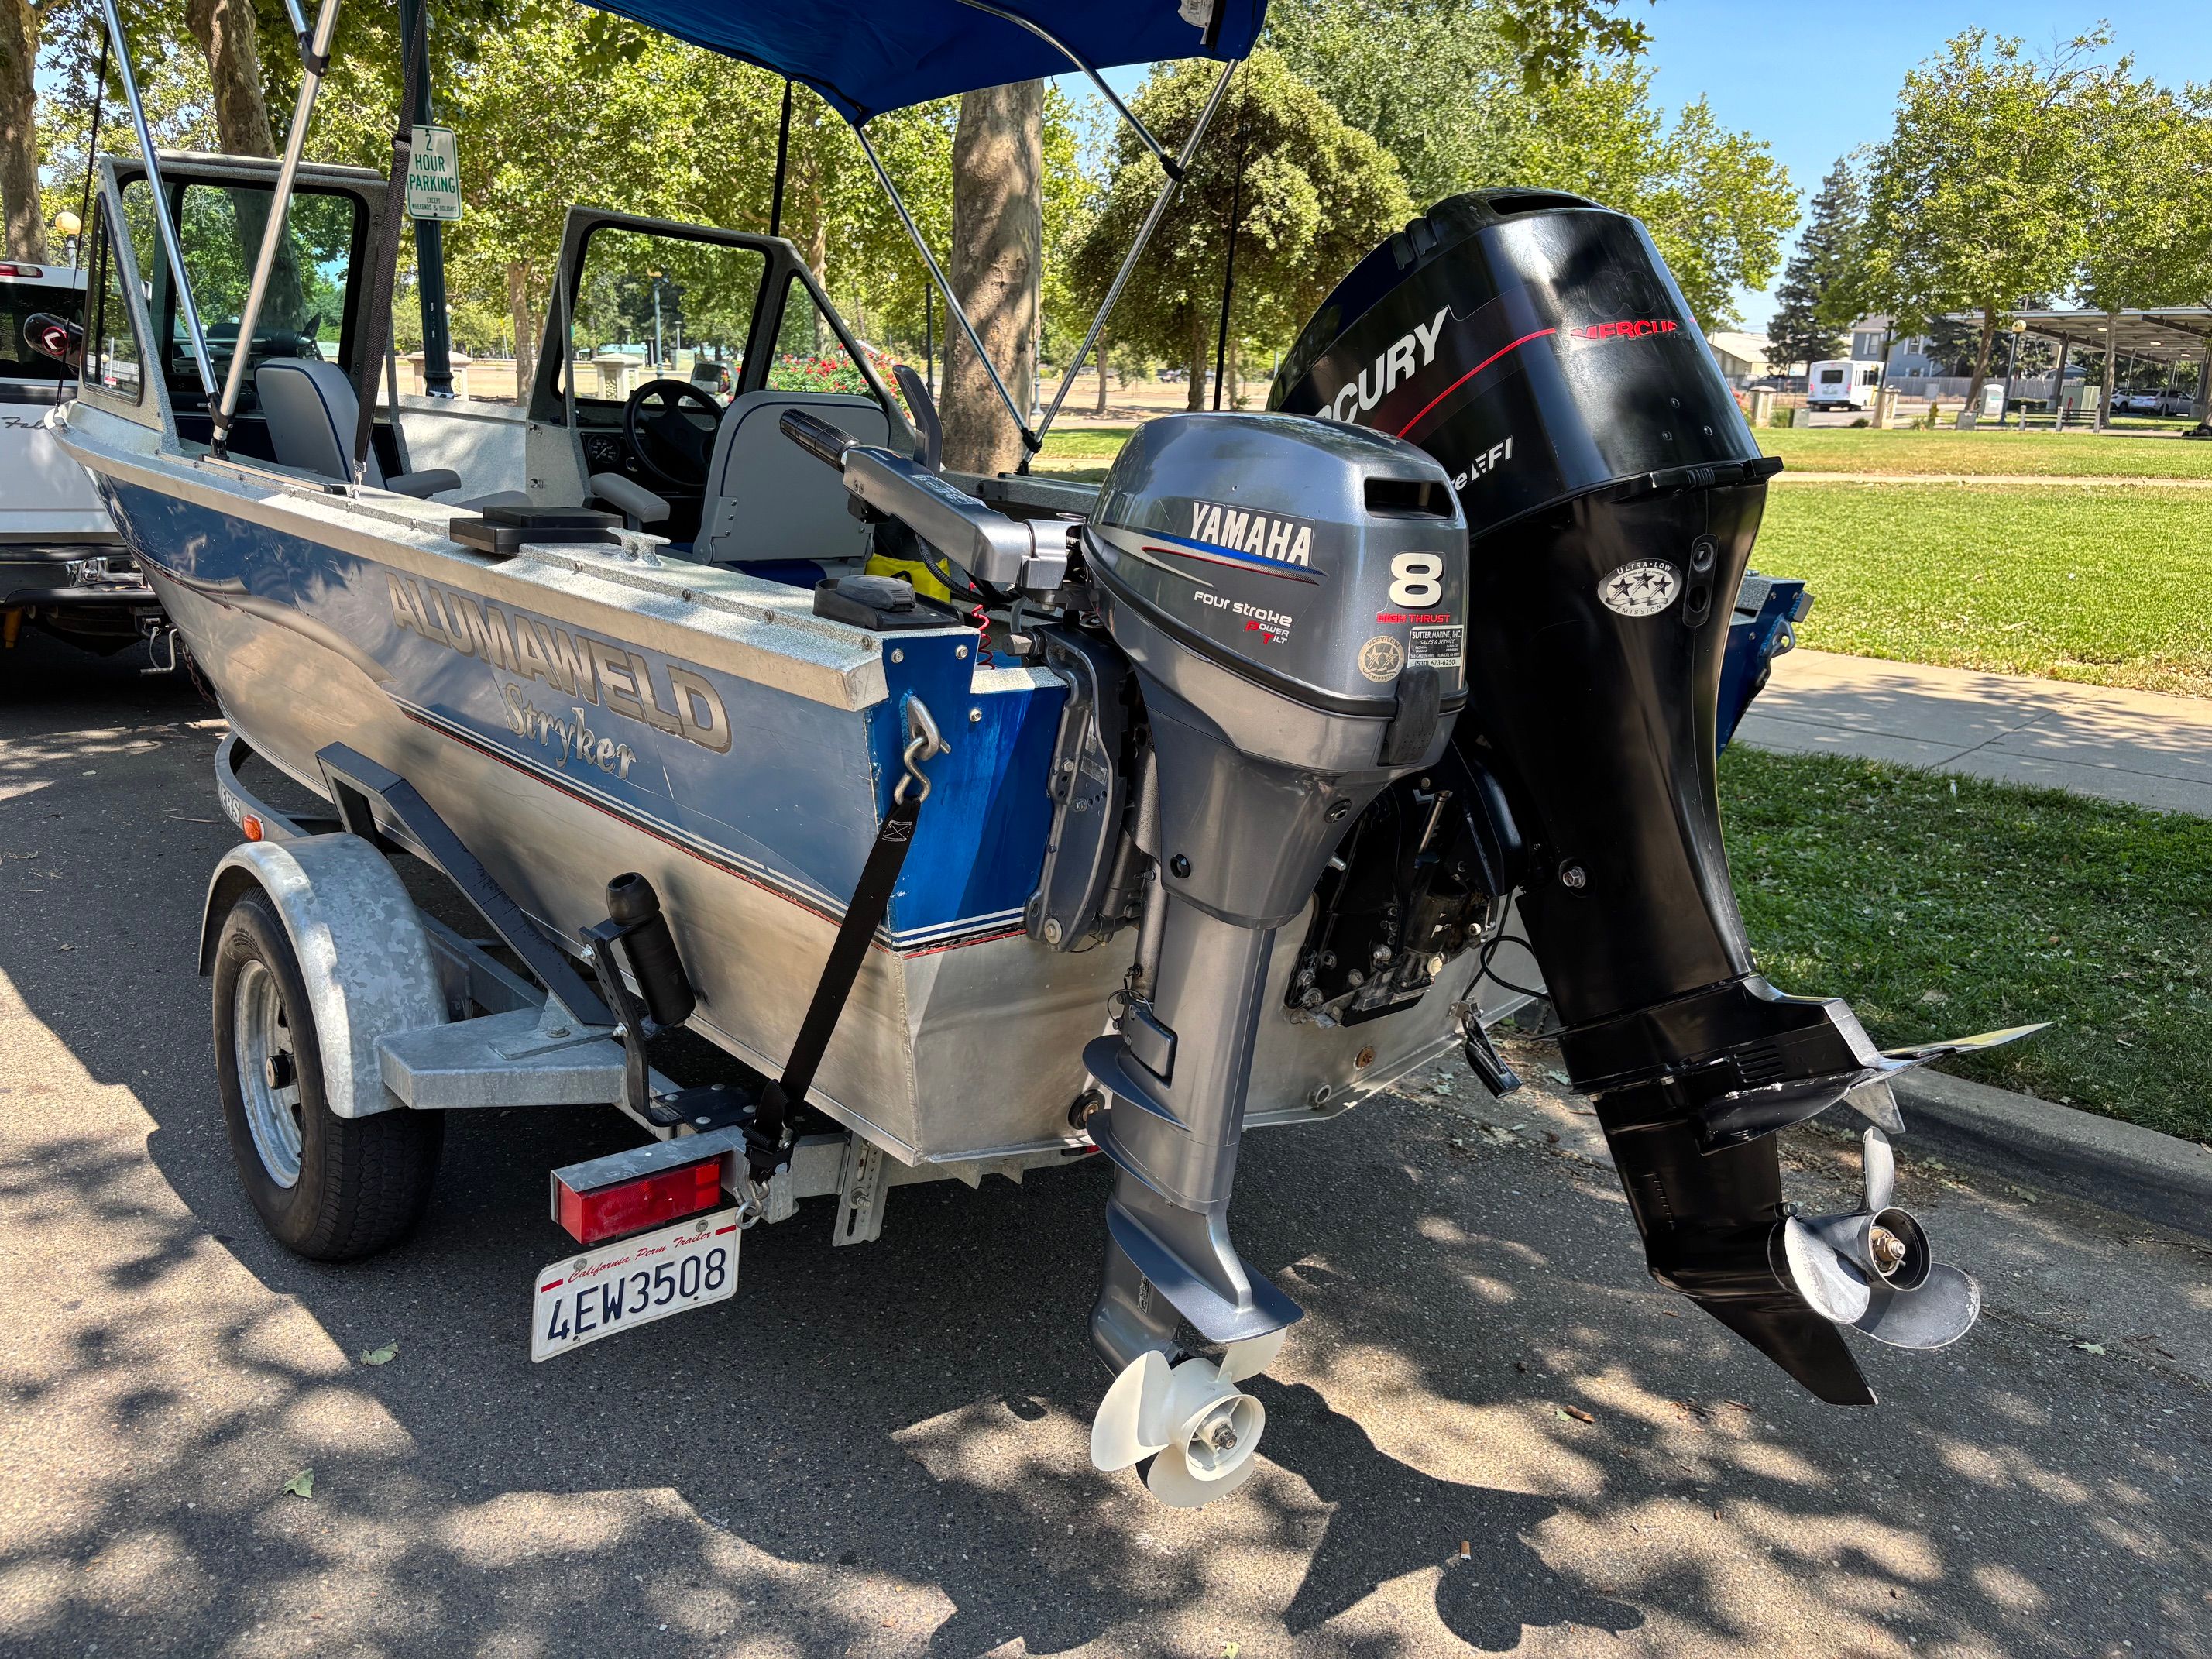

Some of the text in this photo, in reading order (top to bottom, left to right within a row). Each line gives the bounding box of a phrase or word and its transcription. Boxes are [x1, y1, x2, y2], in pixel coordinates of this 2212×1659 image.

[425, 133, 433, 151] 2
[414, 154, 445, 172] HOUR
[409, 174, 455, 193] PARKING
[1190, 502, 1312, 567] YAMAHA
[1389, 552, 1443, 608] 8
[1376, 613, 1451, 623] HIGH THRUST
[1616, 604, 1661, 615] EMISSION
[1245, 620, 1290, 637] POWER
[1431, 630, 1451, 639] MARINE,
[1262, 633, 1288, 644] TILT
[384, 572, 733, 754] ALUMAWELD
[505, 682, 637, 780] Stryker
[568, 1231, 711, 1283] California Perm Trailer
[547, 1247, 726, 1341] 4EW3508
